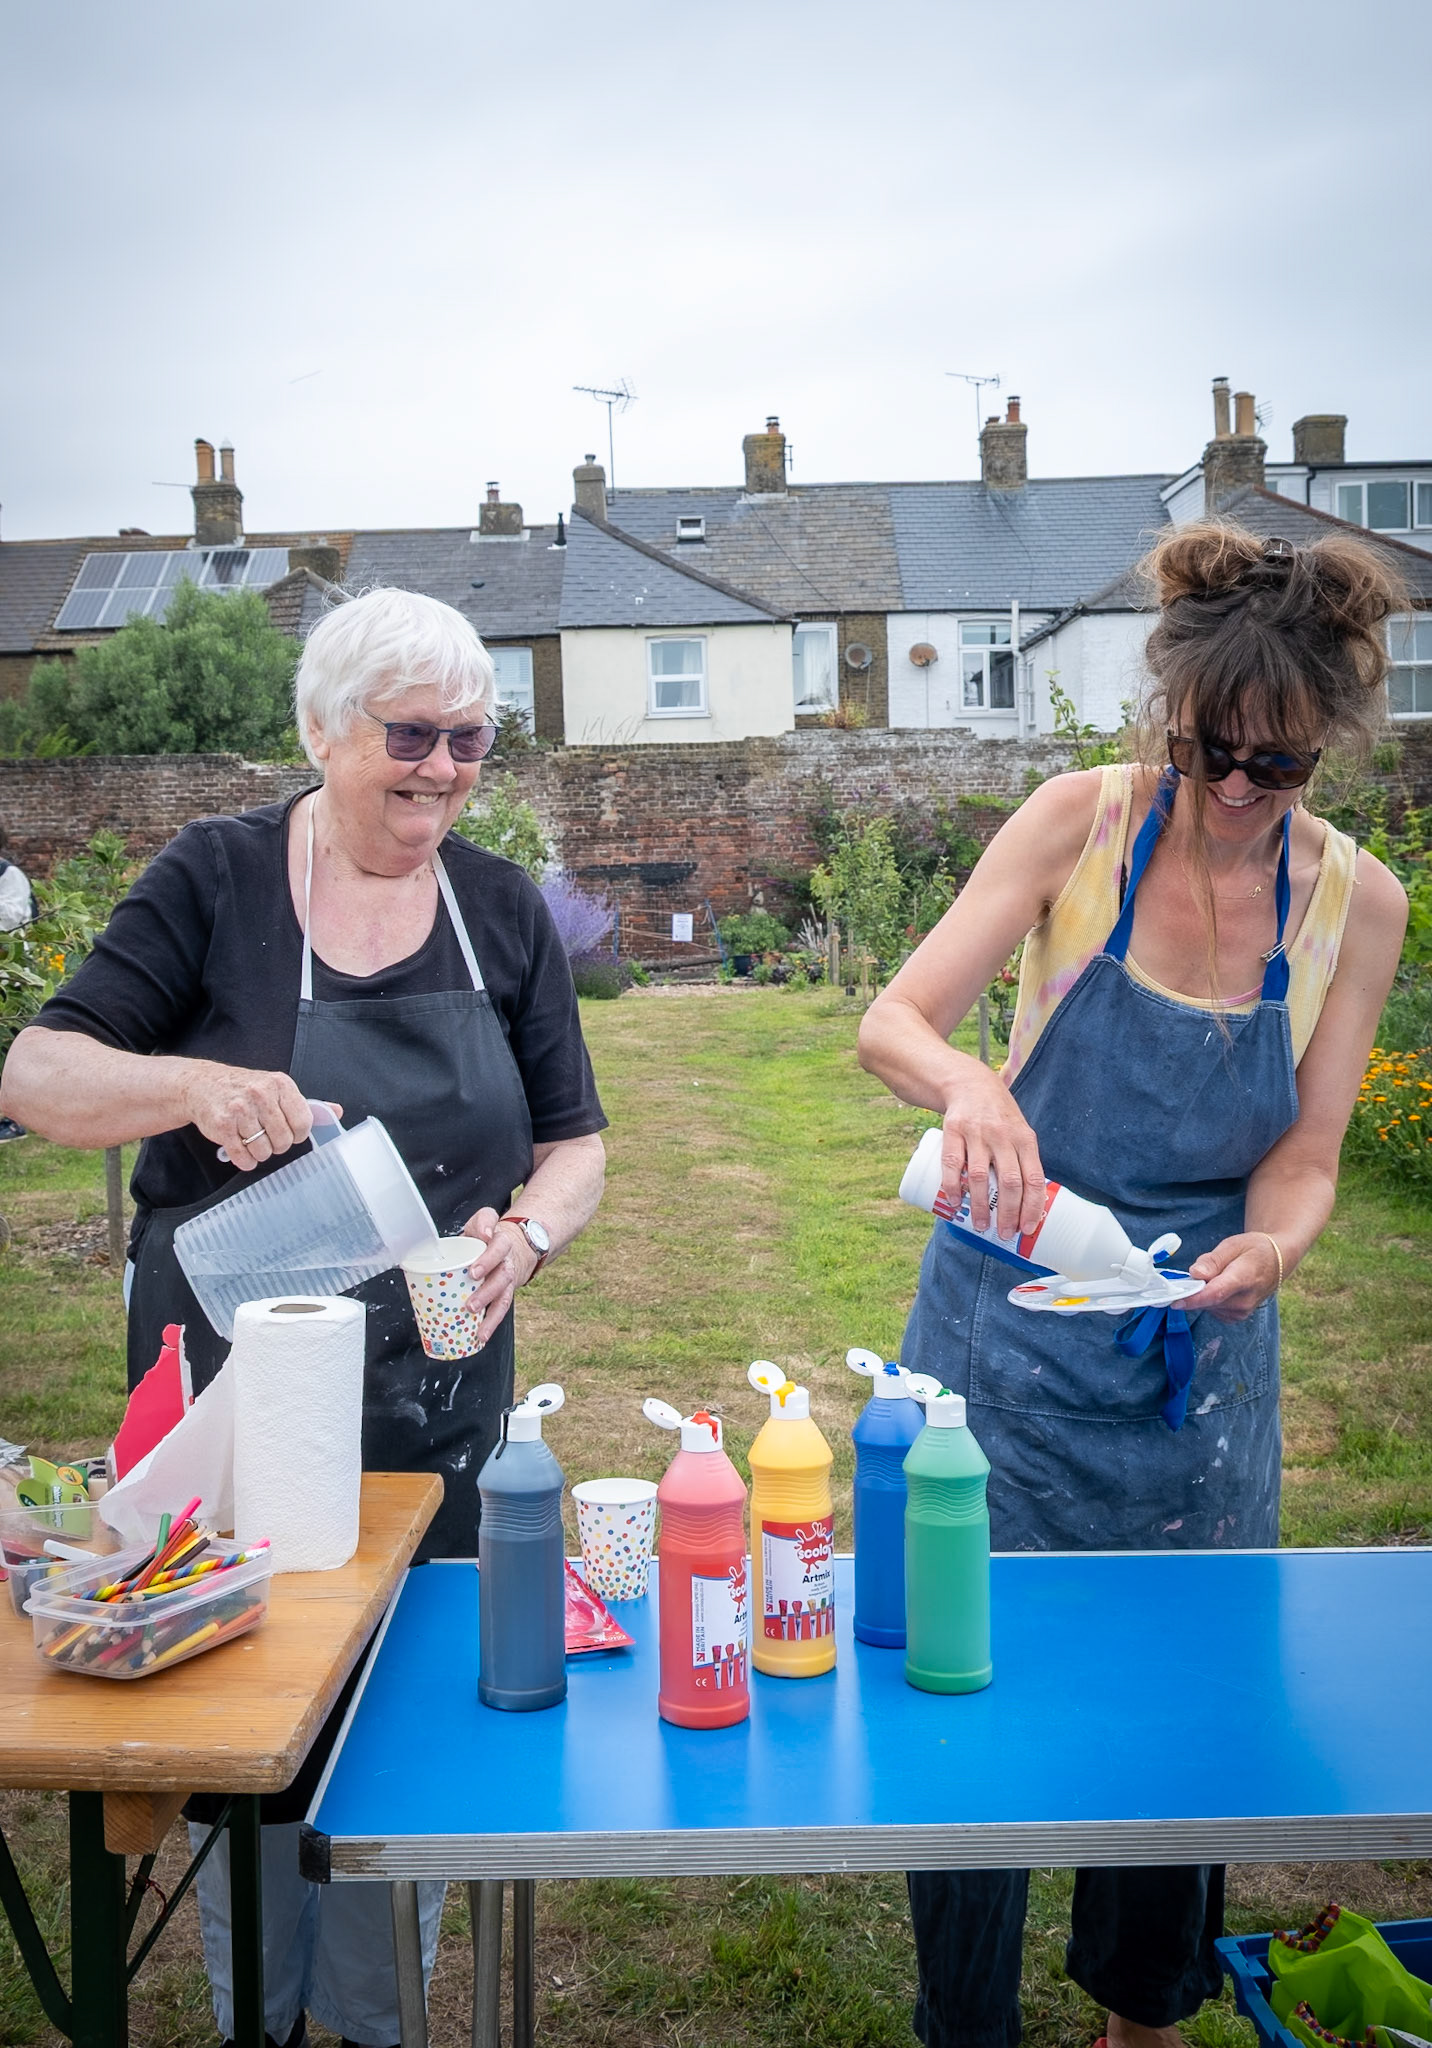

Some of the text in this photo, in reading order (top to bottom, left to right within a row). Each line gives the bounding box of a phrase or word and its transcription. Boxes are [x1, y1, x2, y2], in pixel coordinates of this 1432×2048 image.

[798, 1543, 831, 1559] scola
[802, 1569, 831, 1584] Artmix
[731, 1584, 746, 1598] sco
[695, 1678, 707, 1687] CE
